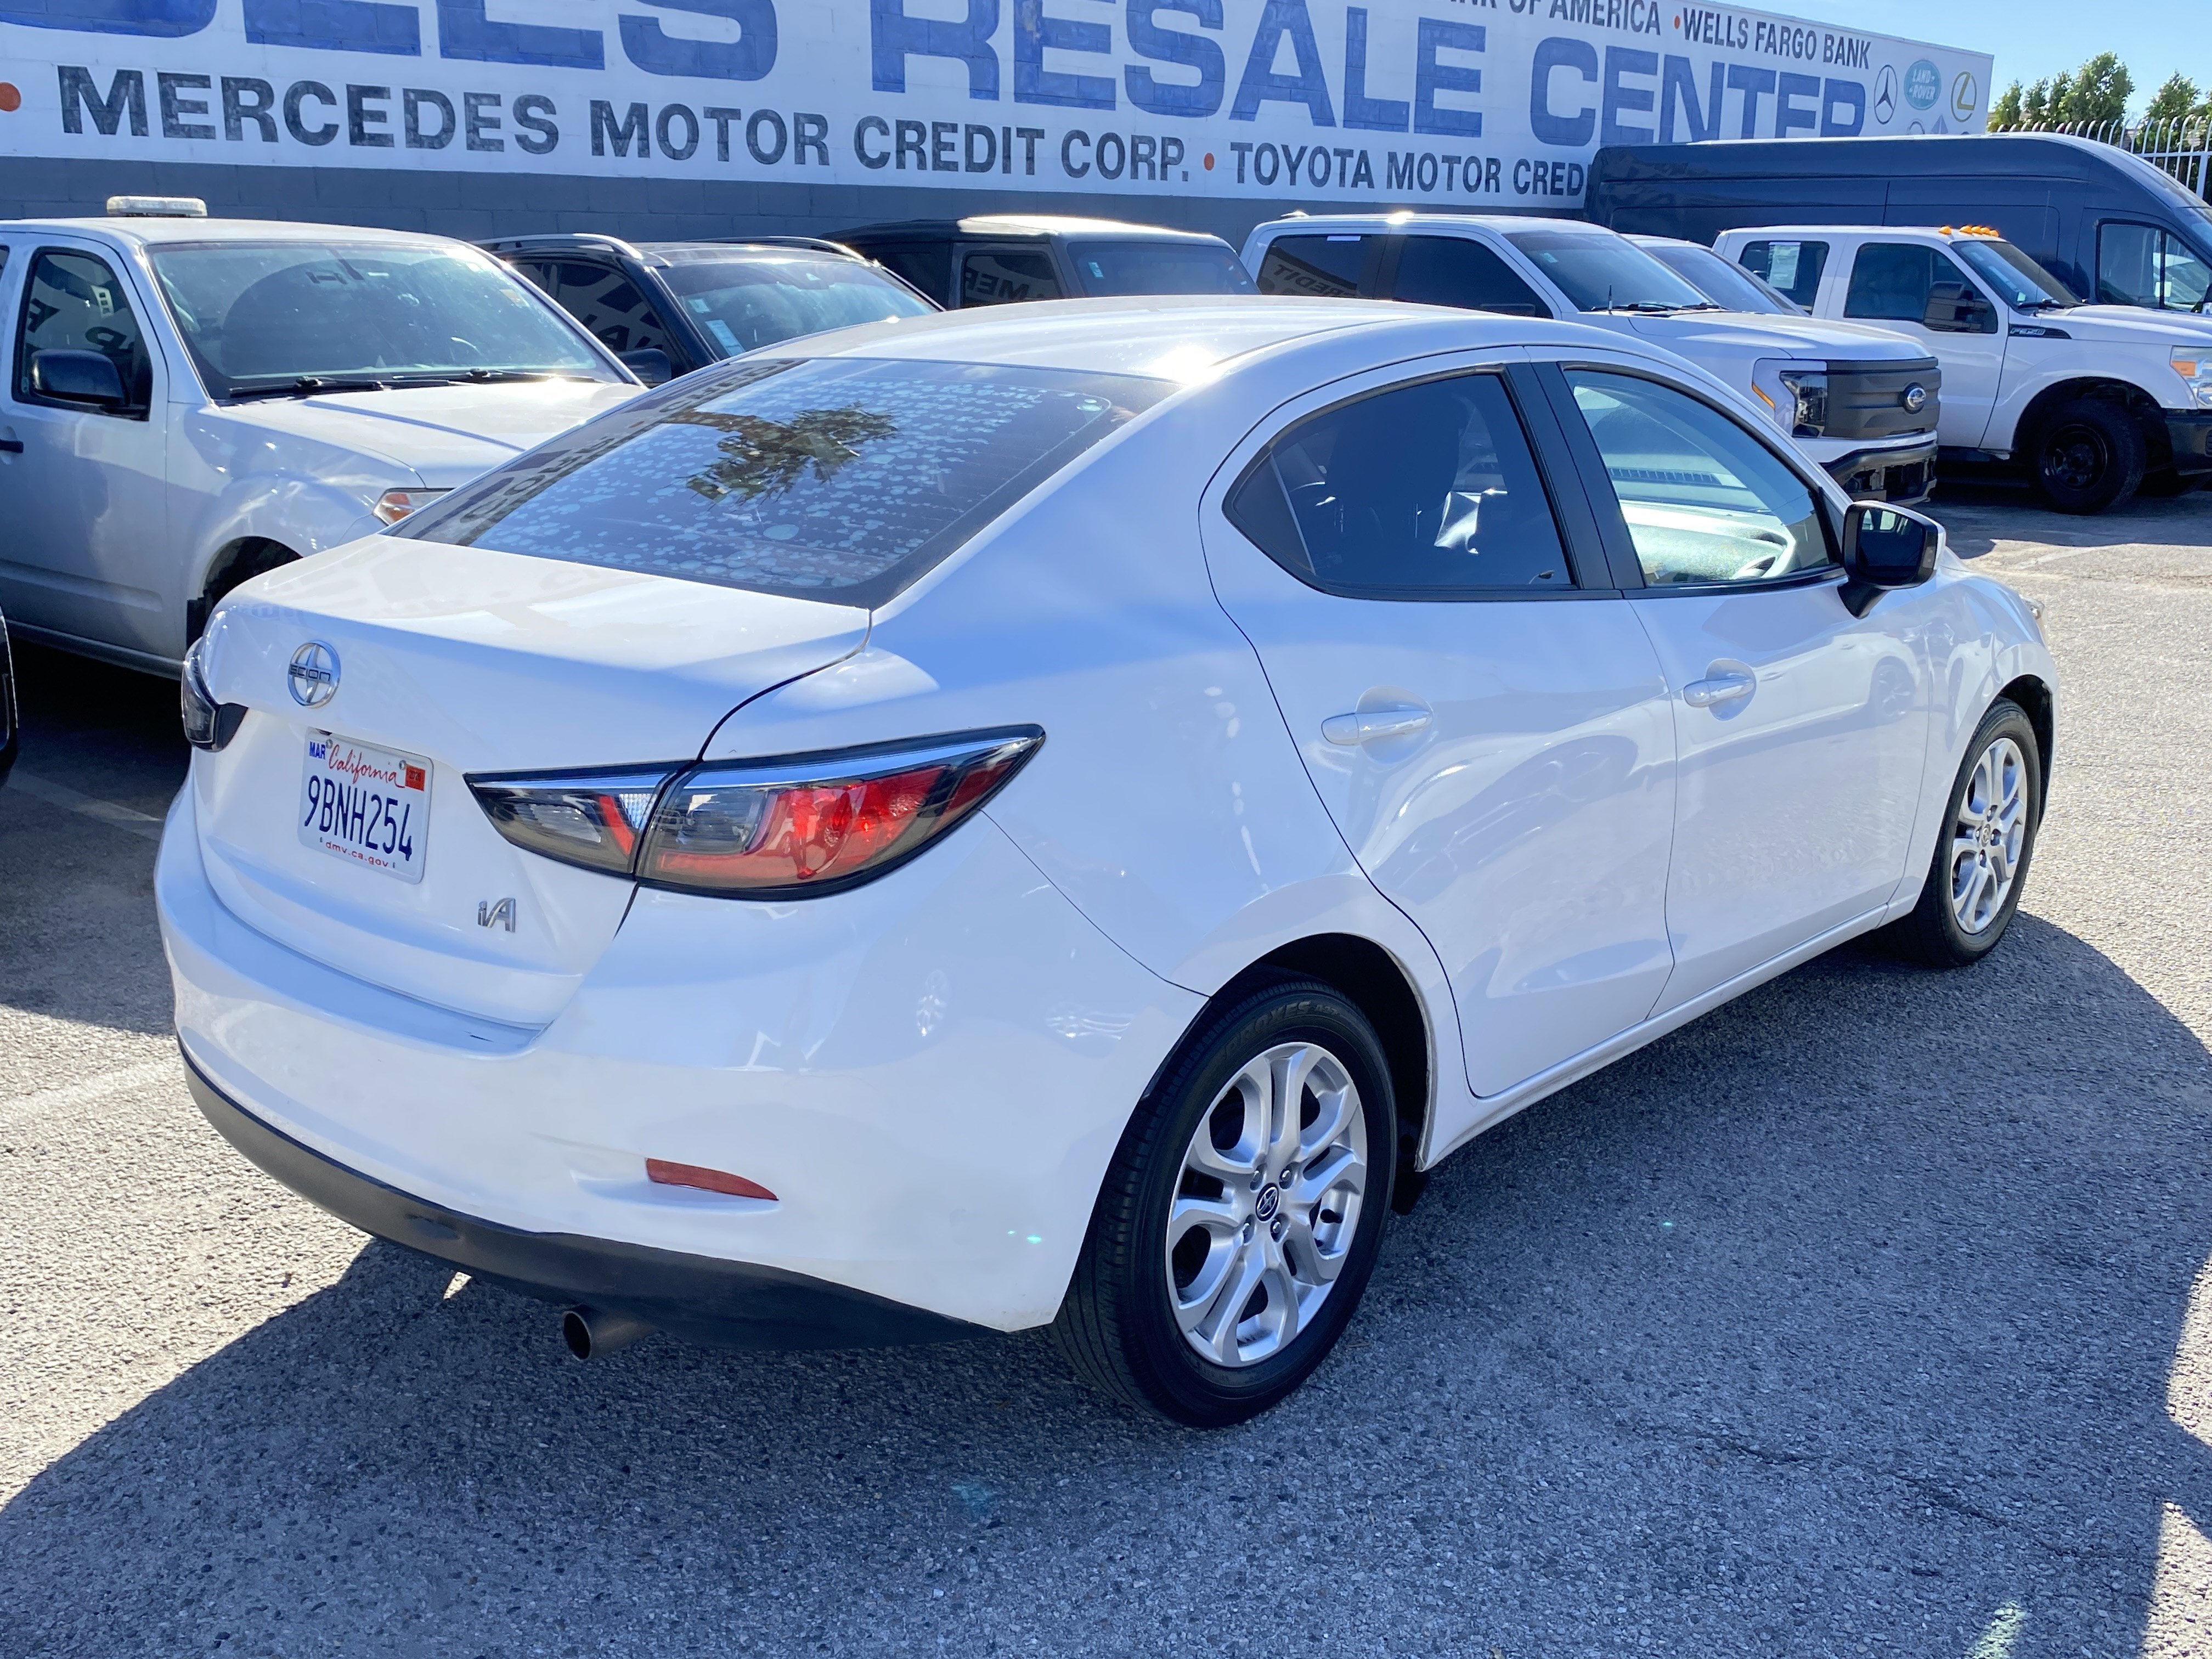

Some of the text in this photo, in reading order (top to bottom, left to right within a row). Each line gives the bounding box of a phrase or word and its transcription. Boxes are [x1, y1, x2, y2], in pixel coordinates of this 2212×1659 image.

[1549, 0, 1871, 69] AMERICA WELLS FARGO BANK
[870, 0, 1486, 137] RESALE
[1911, 69, 1932, 83] LAND
[1912, 85, 1936, 100] ROVER
[57, 65, 560, 155] MERCEDES
[589, 99, 830, 166] MOTOR
[854, 115, 1044, 176] CREDIT
[1061, 129, 1188, 182] CORP.
[1230, 142, 1375, 189] TOYOTA
[1386, 151, 1501, 193] MOTOR
[309, 741, 326, 760] MAR
[329, 744, 405, 788] California
[304, 775, 412, 861] 9BNH254
[326, 841, 388, 867] dmv.ca.gov
